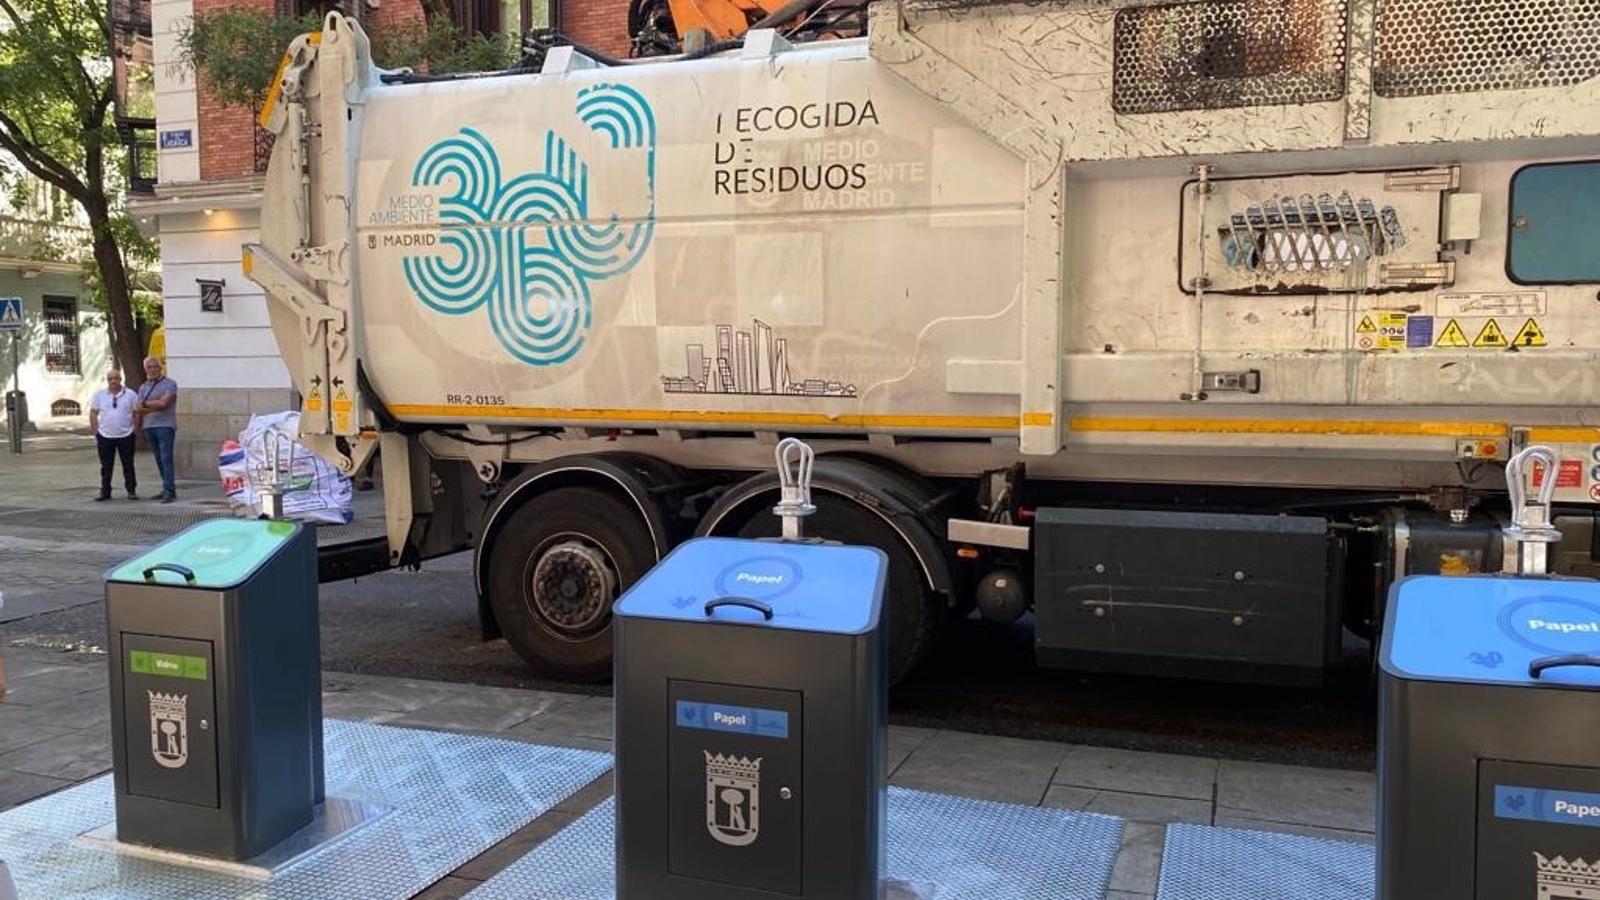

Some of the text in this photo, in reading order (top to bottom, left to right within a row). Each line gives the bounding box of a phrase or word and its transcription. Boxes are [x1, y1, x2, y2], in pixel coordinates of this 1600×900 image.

[803, 139, 879, 162] MEDIO
[714, 163, 867, 195] RESIDUOS
[390, 195, 434, 209] MEDIO
[803, 188, 896, 210] MADRID
[369, 209, 434, 224] AMBIENTE
[383, 234, 436, 247] MADRID
[736, 572, 783, 584] Papel
[1528, 619, 1600, 633] Papel
[713, 711, 747, 726] Papel
[1555, 800, 1600, 818] Pape
